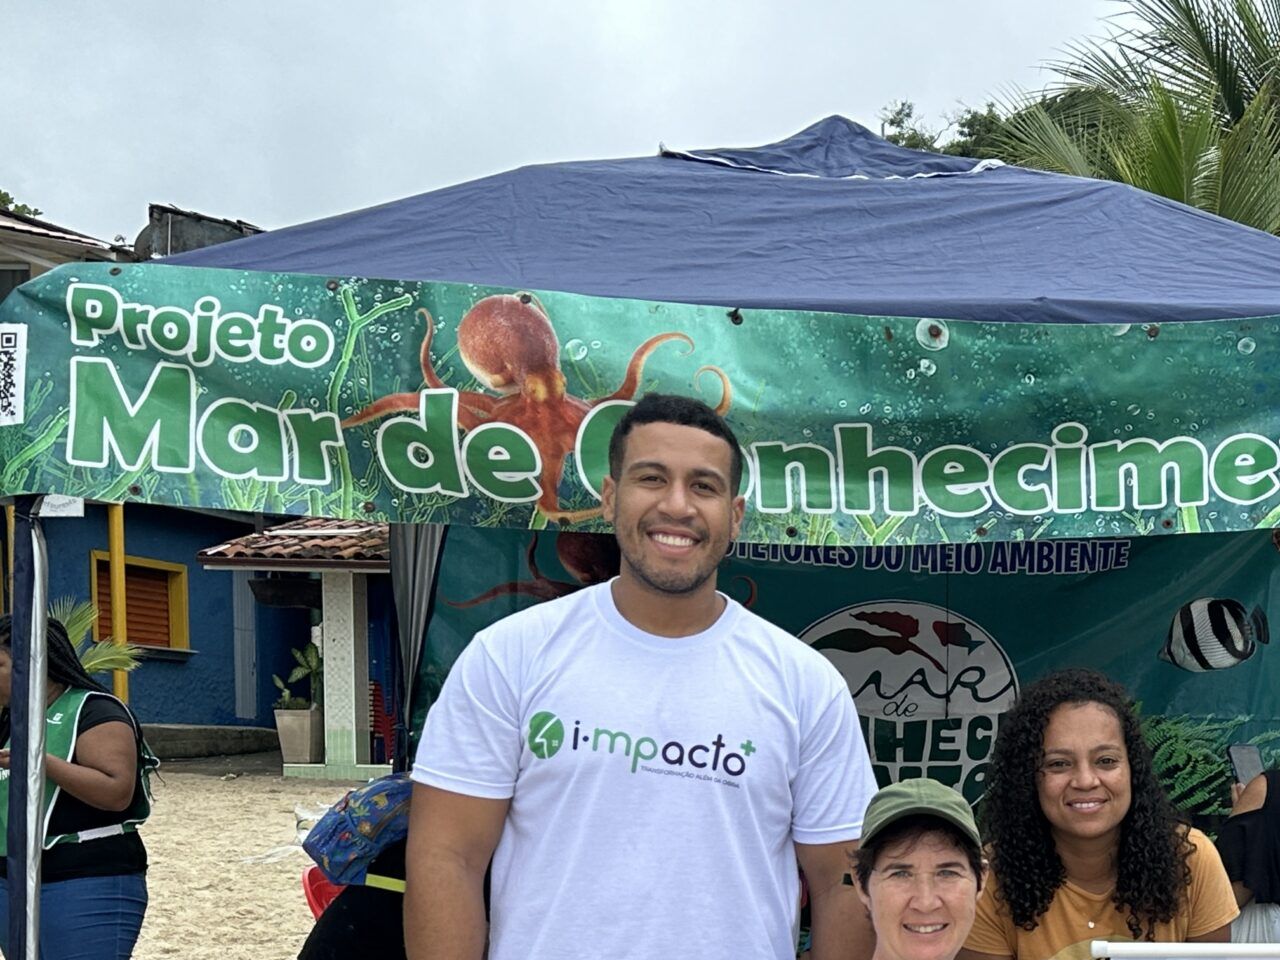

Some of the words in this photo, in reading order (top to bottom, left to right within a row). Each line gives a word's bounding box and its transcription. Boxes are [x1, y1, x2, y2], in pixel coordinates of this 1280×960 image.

[67, 283, 335, 368] Projeto
[66, 356, 344, 484] Mar
[377, 387, 543, 502] de
[910, 541, 983, 574] MEIO
[987, 539, 1131, 575] AMBIENTE
[883, 694, 919, 718] de
